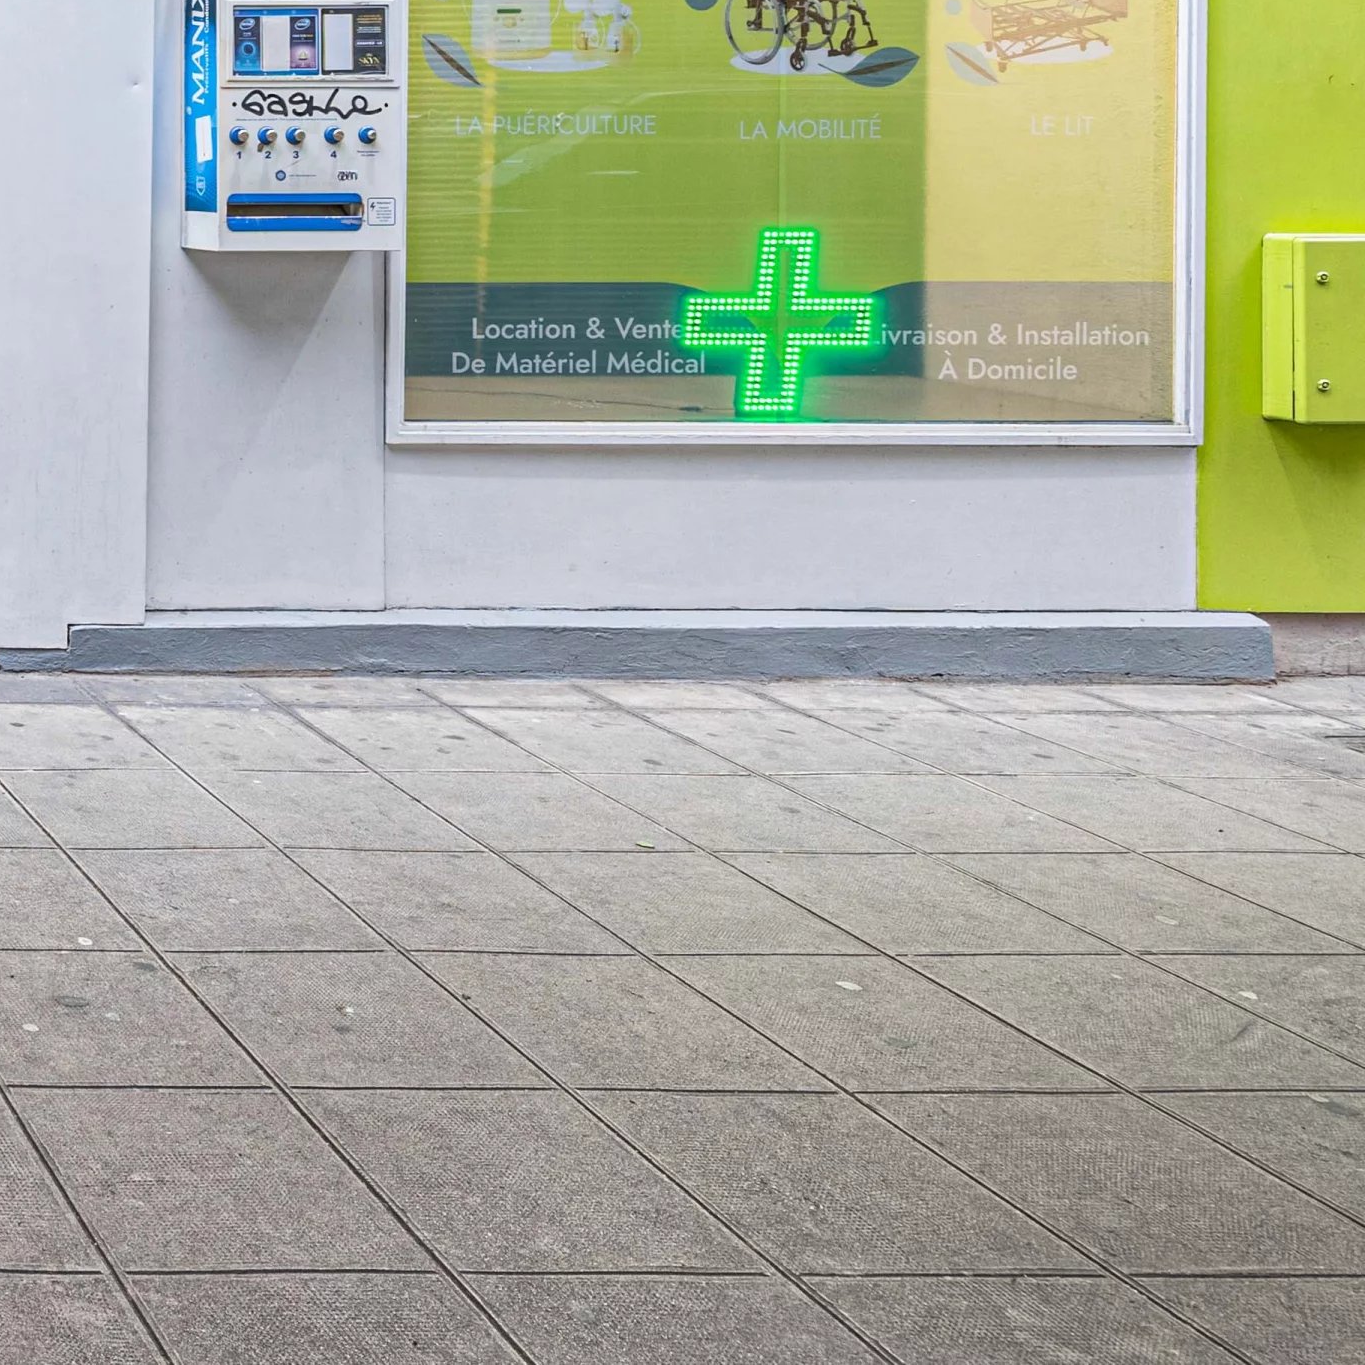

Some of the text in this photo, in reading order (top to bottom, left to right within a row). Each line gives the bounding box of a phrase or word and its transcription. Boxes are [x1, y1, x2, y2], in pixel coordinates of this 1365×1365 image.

[455, 108, 657, 136] LA PUÉRICULTURE
[739, 113, 882, 140] LA MOBILITÉ
[1031, 117, 1094, 135] LE LIT
[237, 151, 243, 159] 1
[265, 151, 272, 159] 2
[293, 151, 300, 159] 3
[330, 151, 338, 159] 4
[472, 317, 575, 340] Location
[585, 317, 605, 340] &
[873, 321, 1150, 346] ivraison & Installation
[451, 350, 705, 374] De Matériel Médical
[938, 350, 1078, 380] À Domicile
